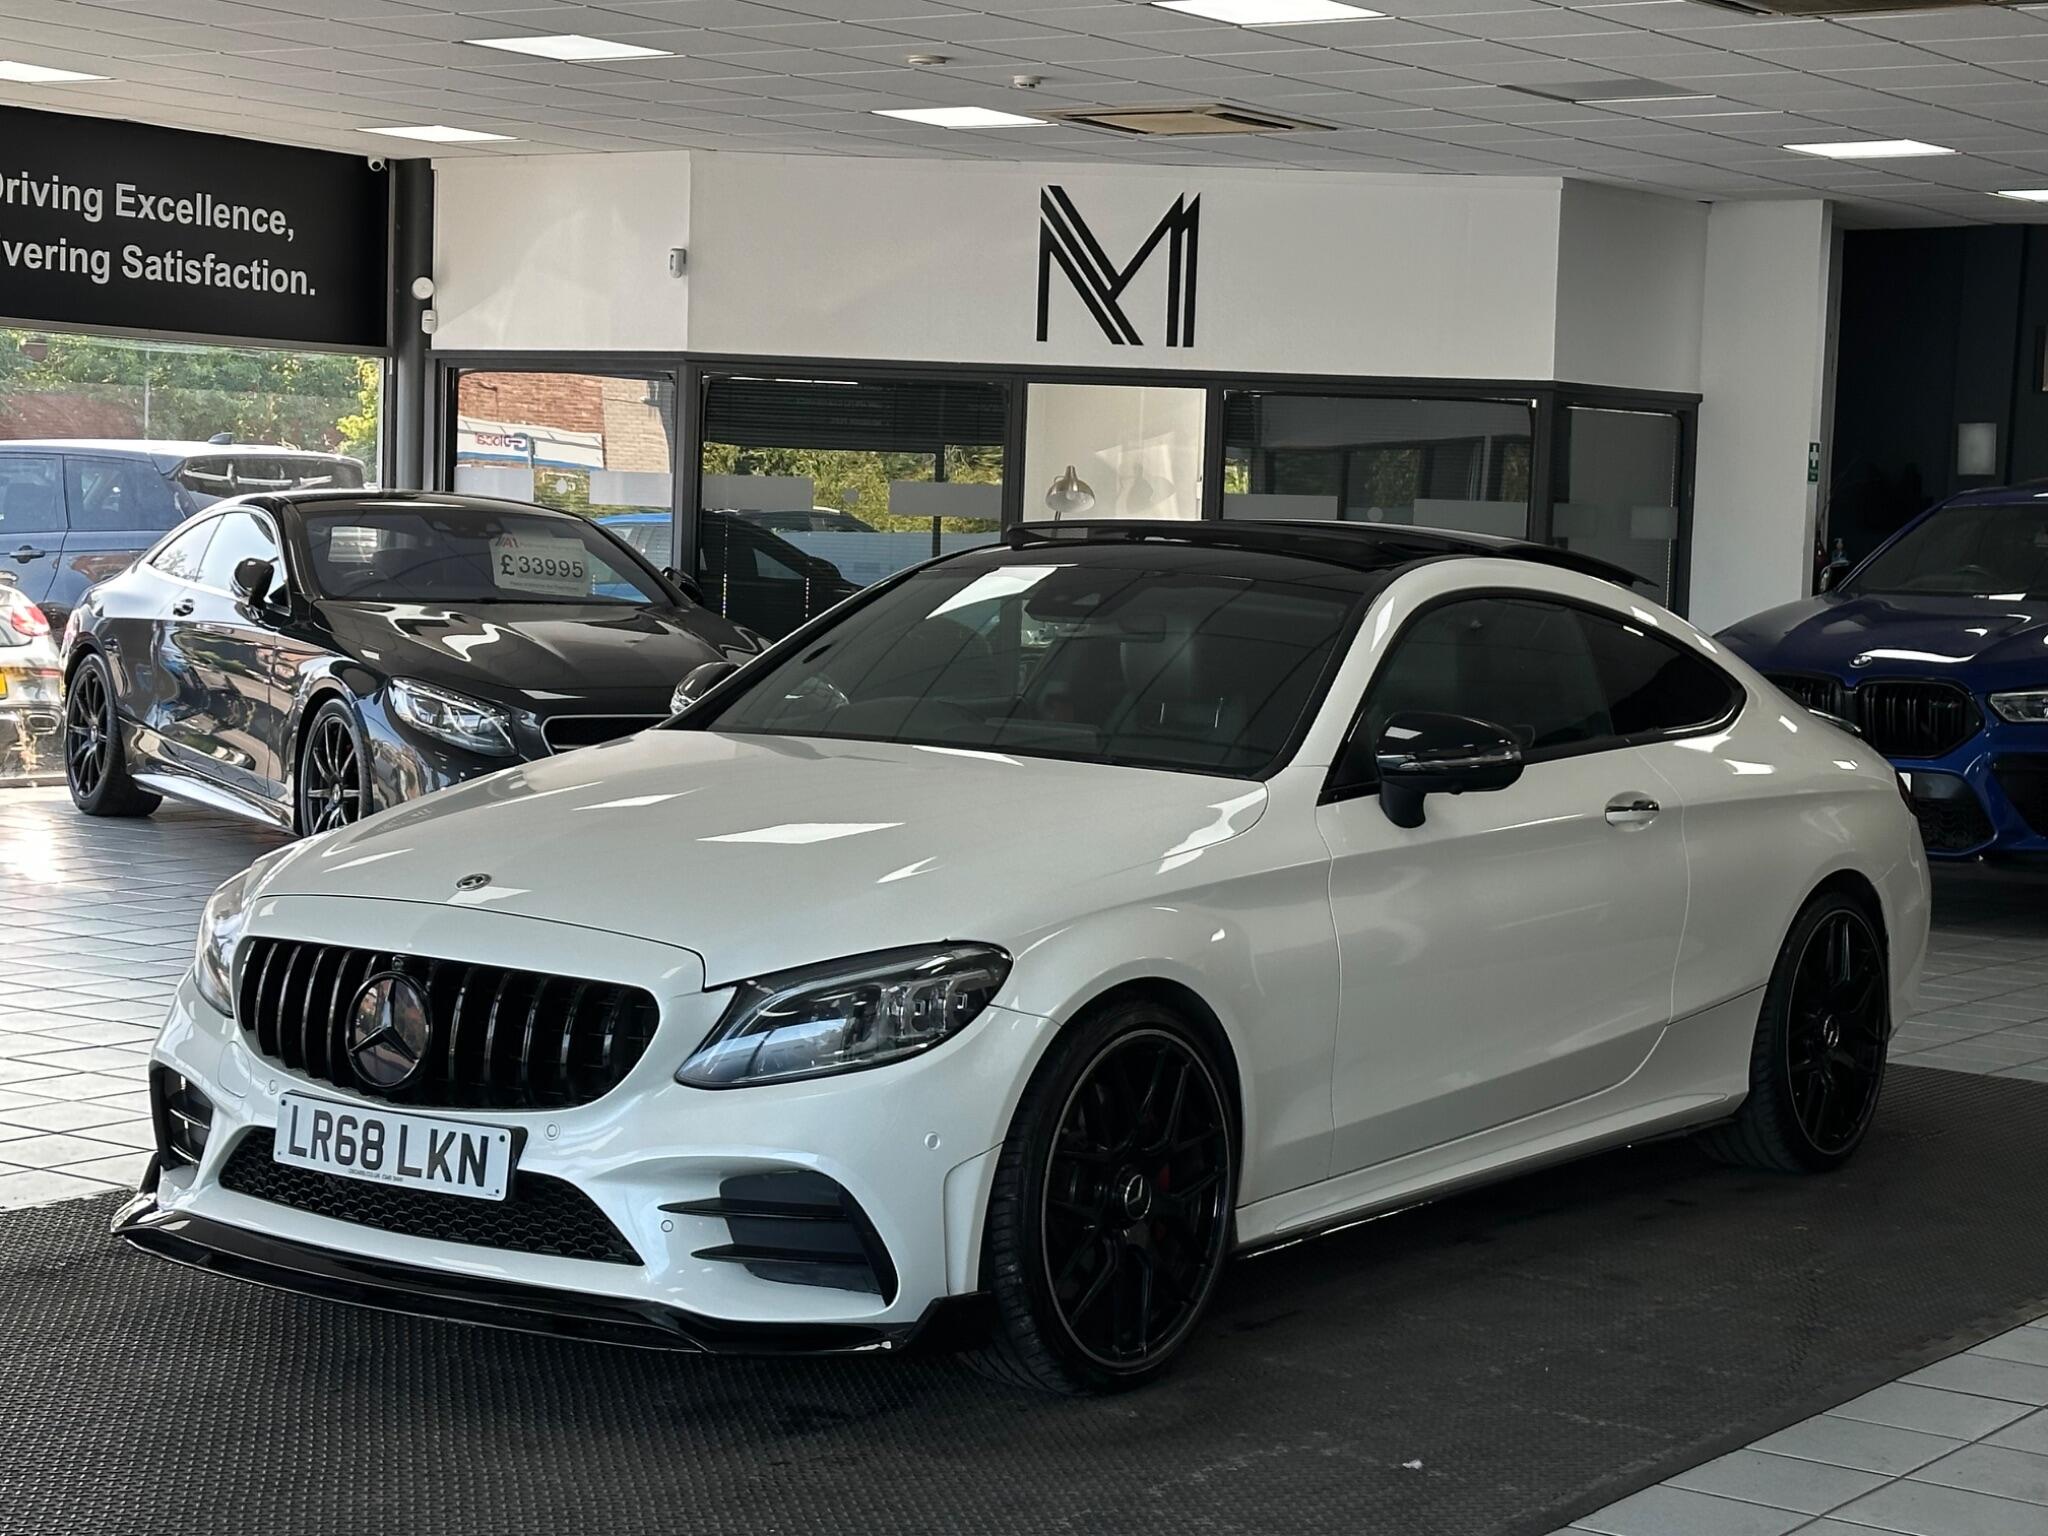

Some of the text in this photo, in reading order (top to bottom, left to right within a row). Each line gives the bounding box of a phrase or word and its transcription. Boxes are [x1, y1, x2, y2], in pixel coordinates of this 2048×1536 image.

[0, 171, 294, 242] riving Excellence,
[121, 244, 316, 296] Satisfaction.
[500, 554, 584, 578] £33995
[288, 1104, 489, 1187] LR68 LKN
